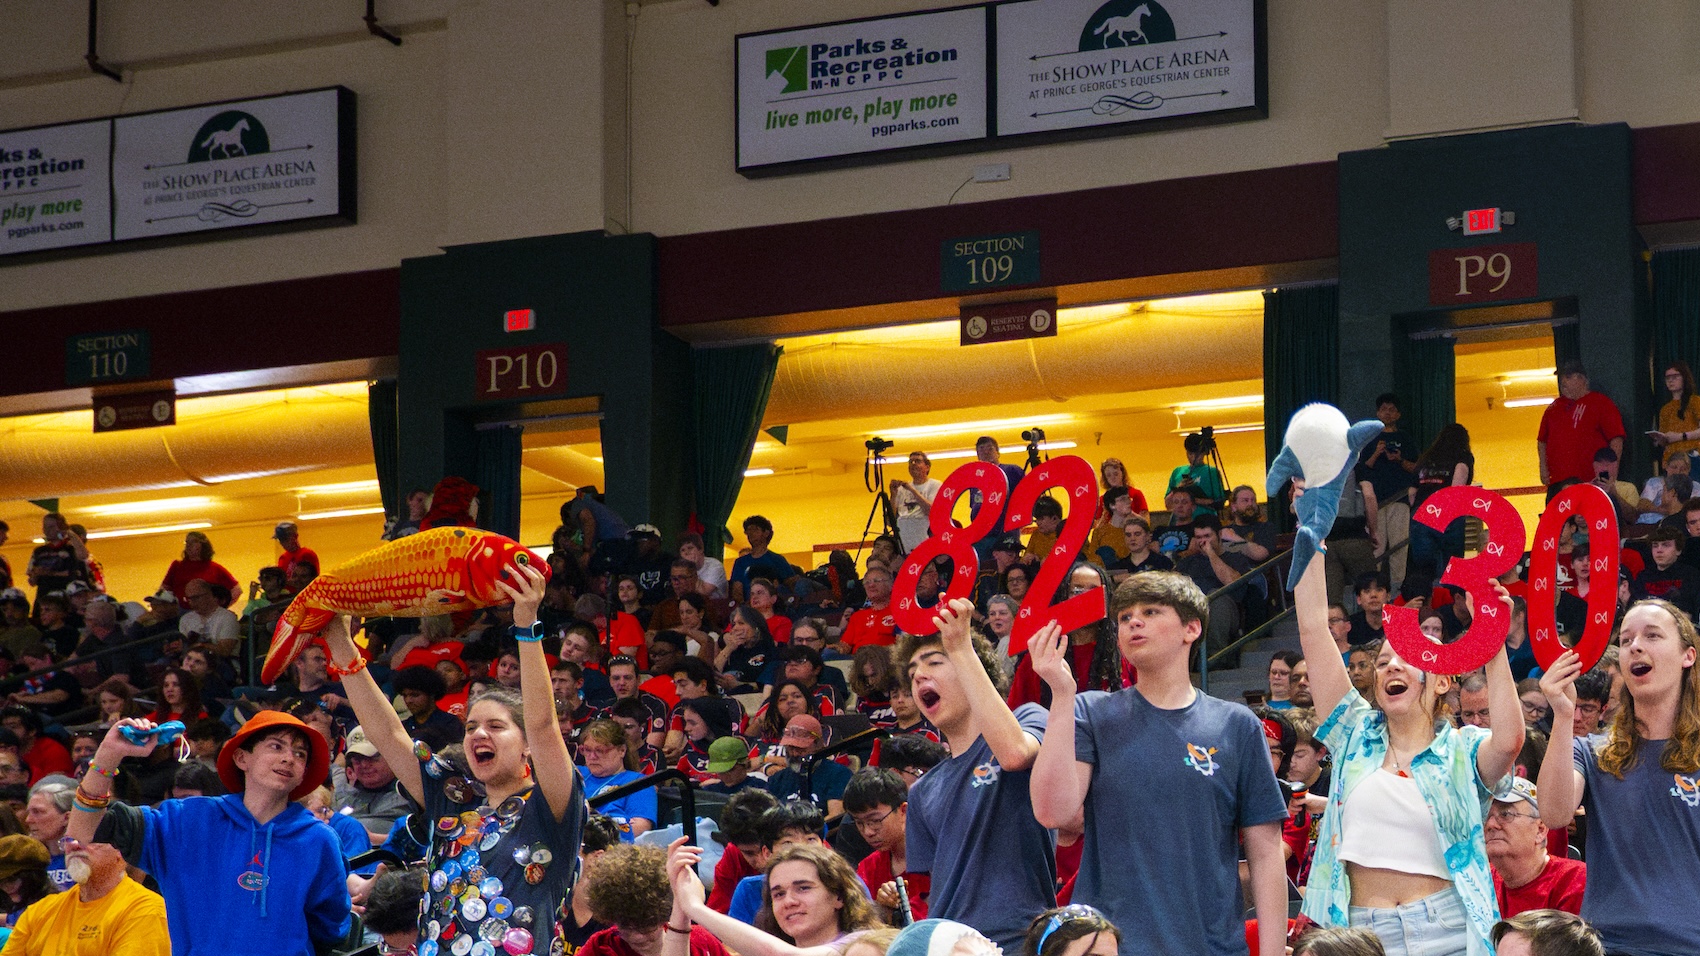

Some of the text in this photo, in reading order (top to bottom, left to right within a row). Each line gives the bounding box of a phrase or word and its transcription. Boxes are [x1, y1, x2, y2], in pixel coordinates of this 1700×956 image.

[811, 38, 908, 61] Parks &
[811, 48, 957, 78] Recreation
[1028, 49, 1230, 83] THE SHOW PLACE ARENA
[1029, 66, 1230, 100] AT PRINCE GEORGE'S EQUESTRIAN CENTER
[765, 93, 958, 131] live more, play more
[872, 116, 959, 137] pgparks.com
[0, 158, 85, 180] reation
[161, 174, 212, 191] SHOW
[214, 167, 259, 184] PLACE
[263, 159, 315, 178] ARENA
[229, 181, 282, 197] EQUESTRIAN
[284, 176, 317, 189] CENTER
[1, 198, 83, 227] play more
[1468, 208, 1496, 231] EXIT
[8, 221, 84, 239] pgparks.com
[954, 236, 1024, 257] SECTION
[967, 255, 1013, 284] 109
[1454, 253, 1512, 296] P9
[1035, 315, 1047, 328] D
[77, 334, 138, 352] SECTION
[89, 352, 127, 378] 110
[486, 350, 558, 393] P10
